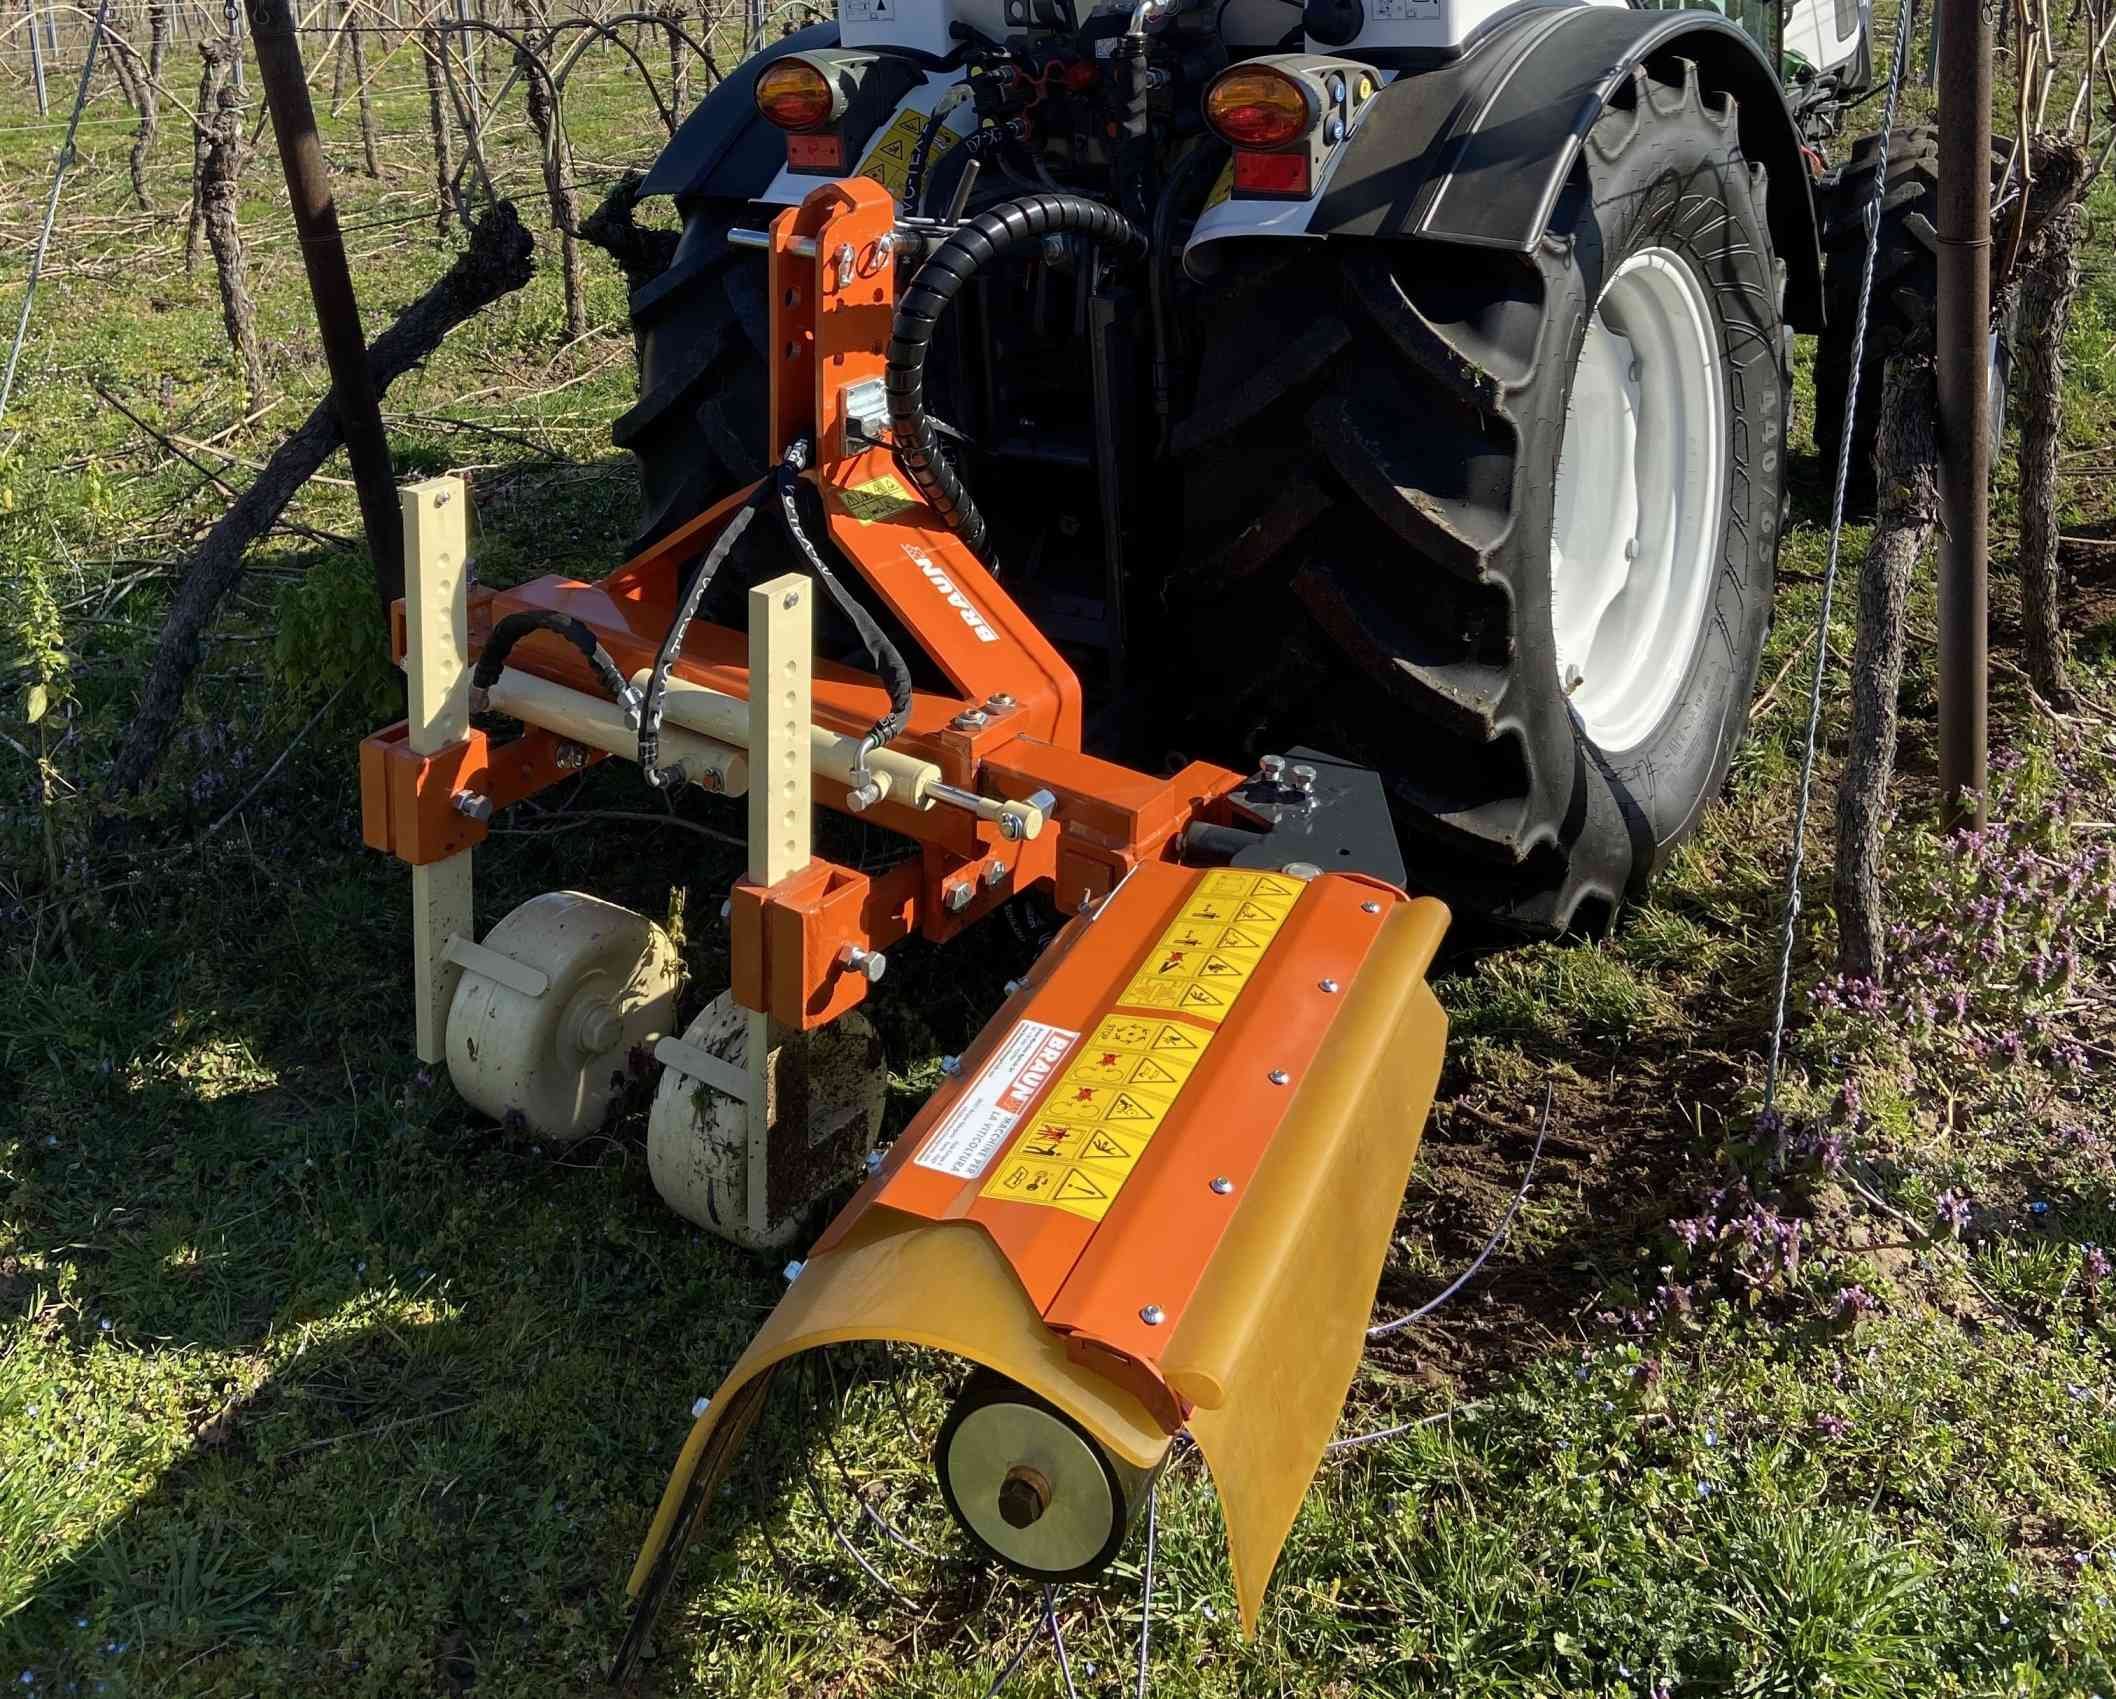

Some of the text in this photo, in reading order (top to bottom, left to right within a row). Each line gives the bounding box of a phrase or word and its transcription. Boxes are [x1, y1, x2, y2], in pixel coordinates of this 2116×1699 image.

[914, 558, 1000, 642] BRAUN
[1010, 1037, 1069, 1101] BRAUN
[987, 1110, 1002, 1121] LA
[950, 1122, 993, 1172] VITICOLTURA
[964, 1117, 1013, 1174] MACCHINE PER
